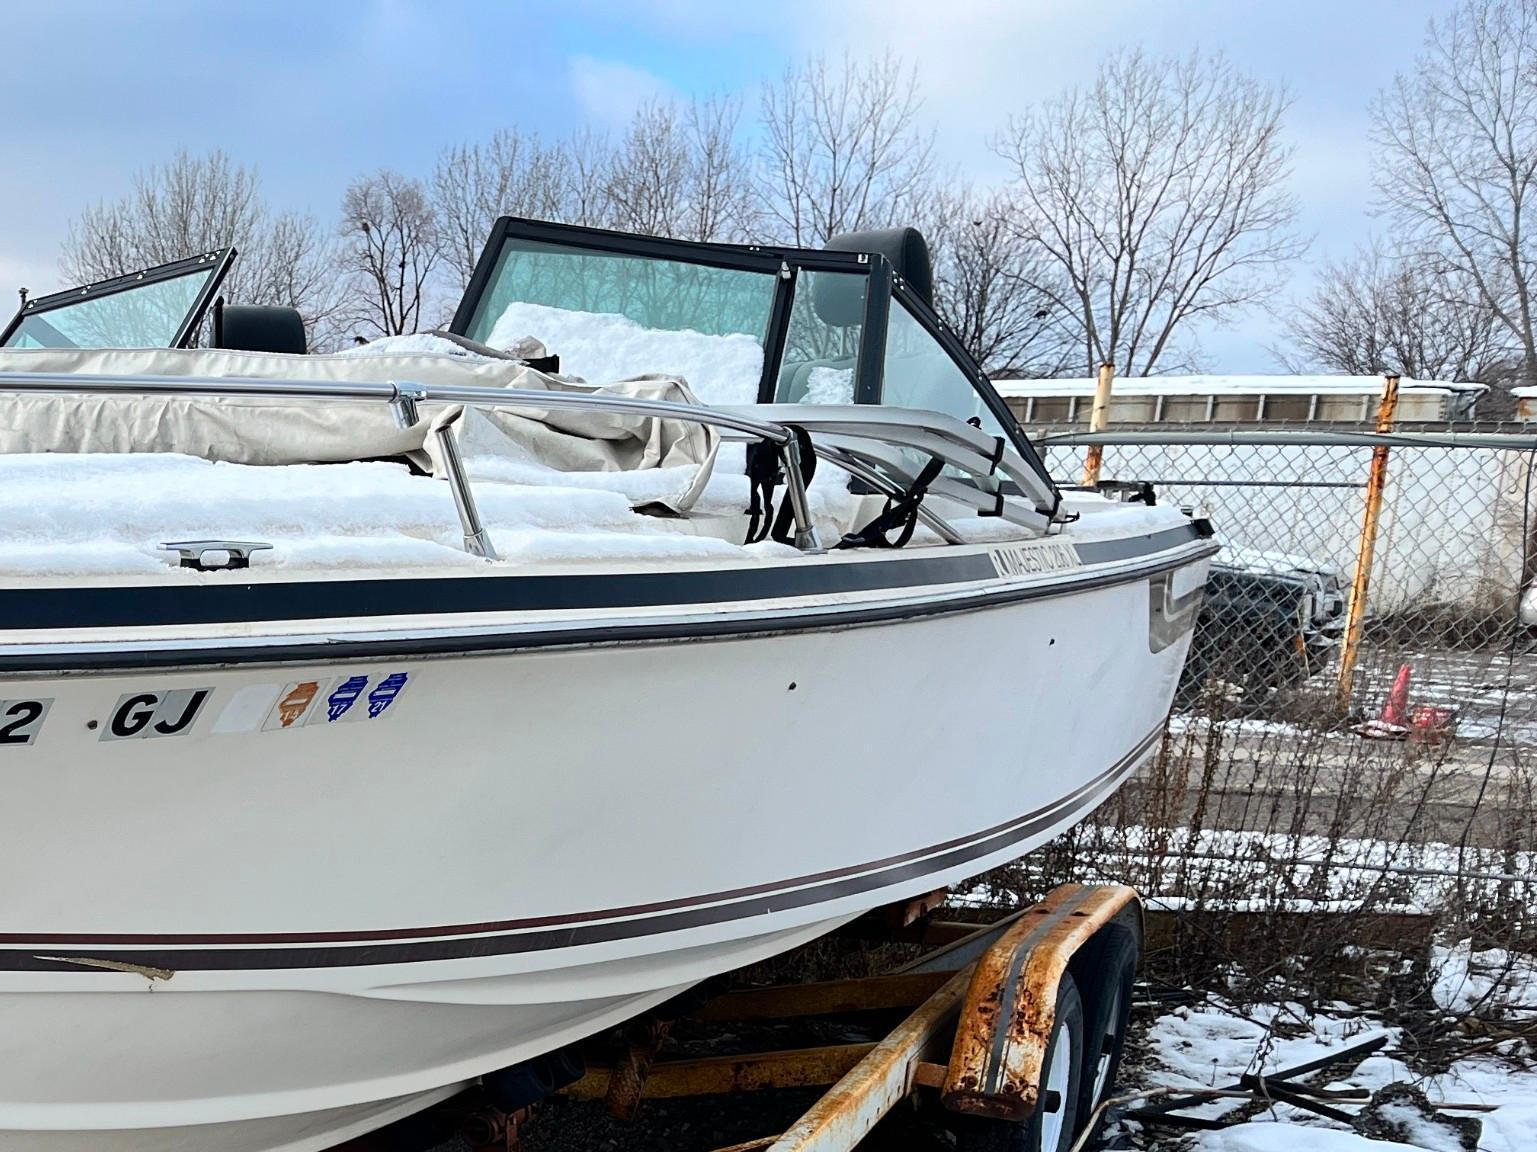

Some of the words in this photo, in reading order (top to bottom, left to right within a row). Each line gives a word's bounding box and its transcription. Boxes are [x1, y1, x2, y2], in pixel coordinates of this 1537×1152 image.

[1002, 545, 1056, 574] MAJESTIC
[111, 690, 209, 737] GJ
[330, 704, 348, 716] 17
[370, 700, 387, 713] 21
